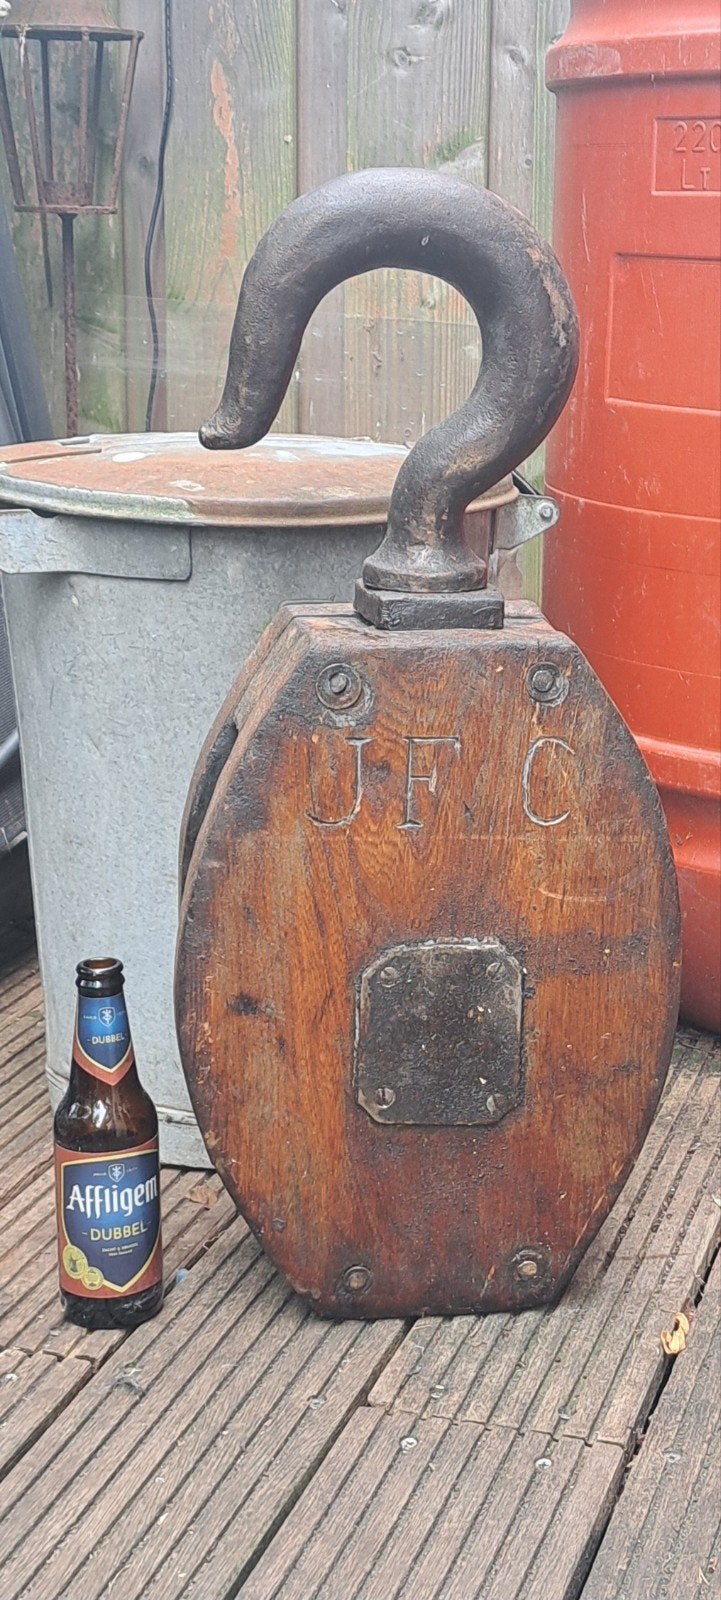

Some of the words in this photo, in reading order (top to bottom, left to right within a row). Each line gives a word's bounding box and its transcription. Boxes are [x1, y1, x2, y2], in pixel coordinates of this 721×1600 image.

[91, 1032, 126, 1045] DUBBEL
[66, 1174, 159, 1220] Affligem
[90, 1221, 149, 1242] DUBBEL
